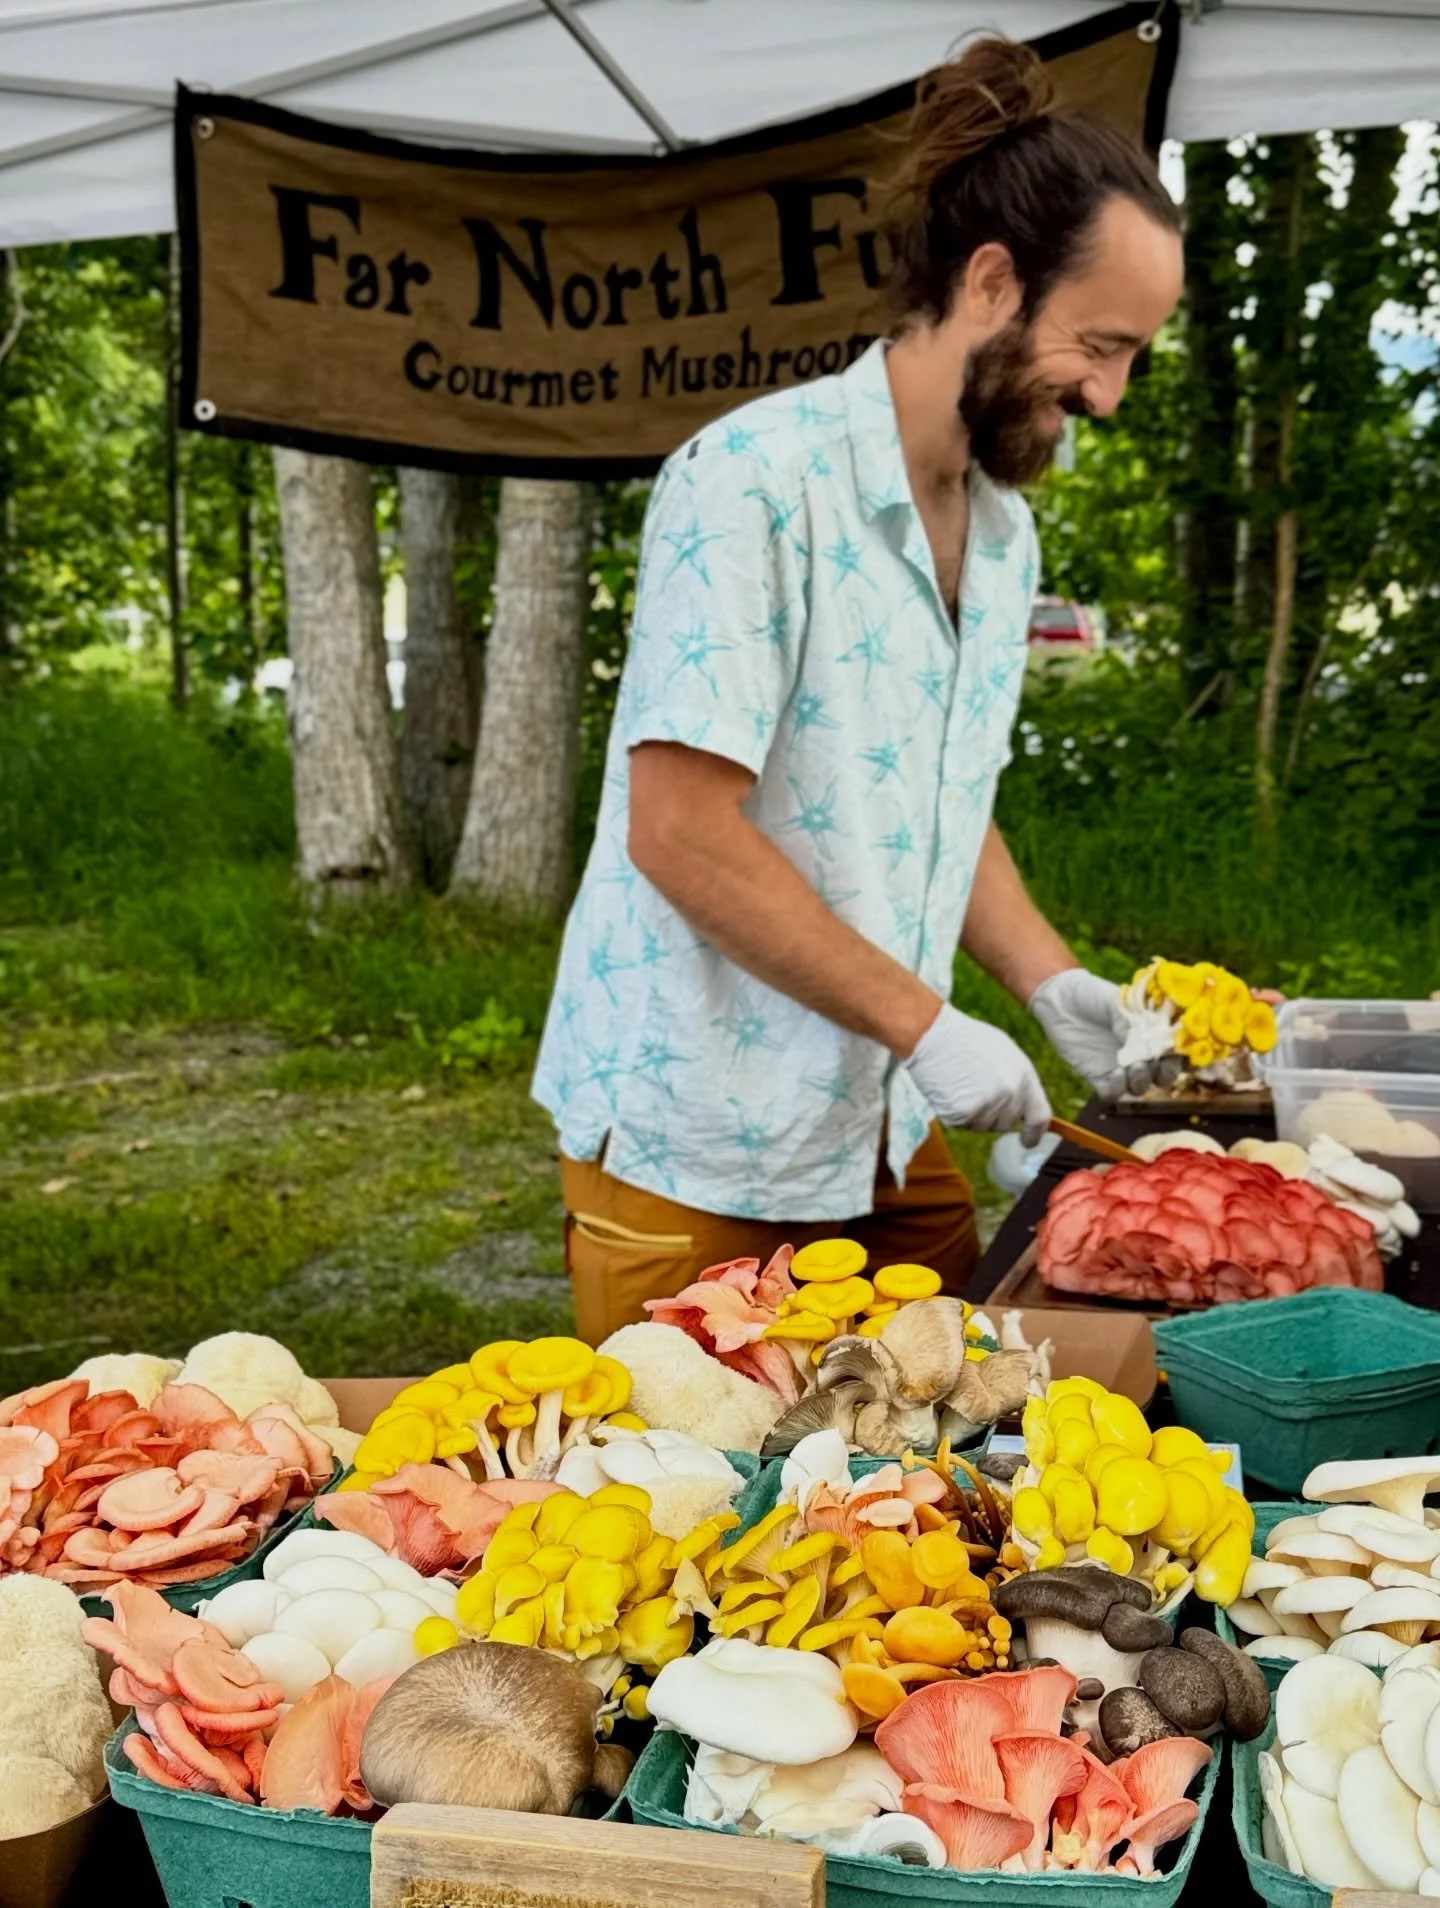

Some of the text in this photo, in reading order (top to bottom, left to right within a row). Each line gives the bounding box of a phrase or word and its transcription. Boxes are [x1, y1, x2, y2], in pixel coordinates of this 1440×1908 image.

[267, 177, 902, 330] Far North Fu
[404, 340, 619, 407] Gourmet
